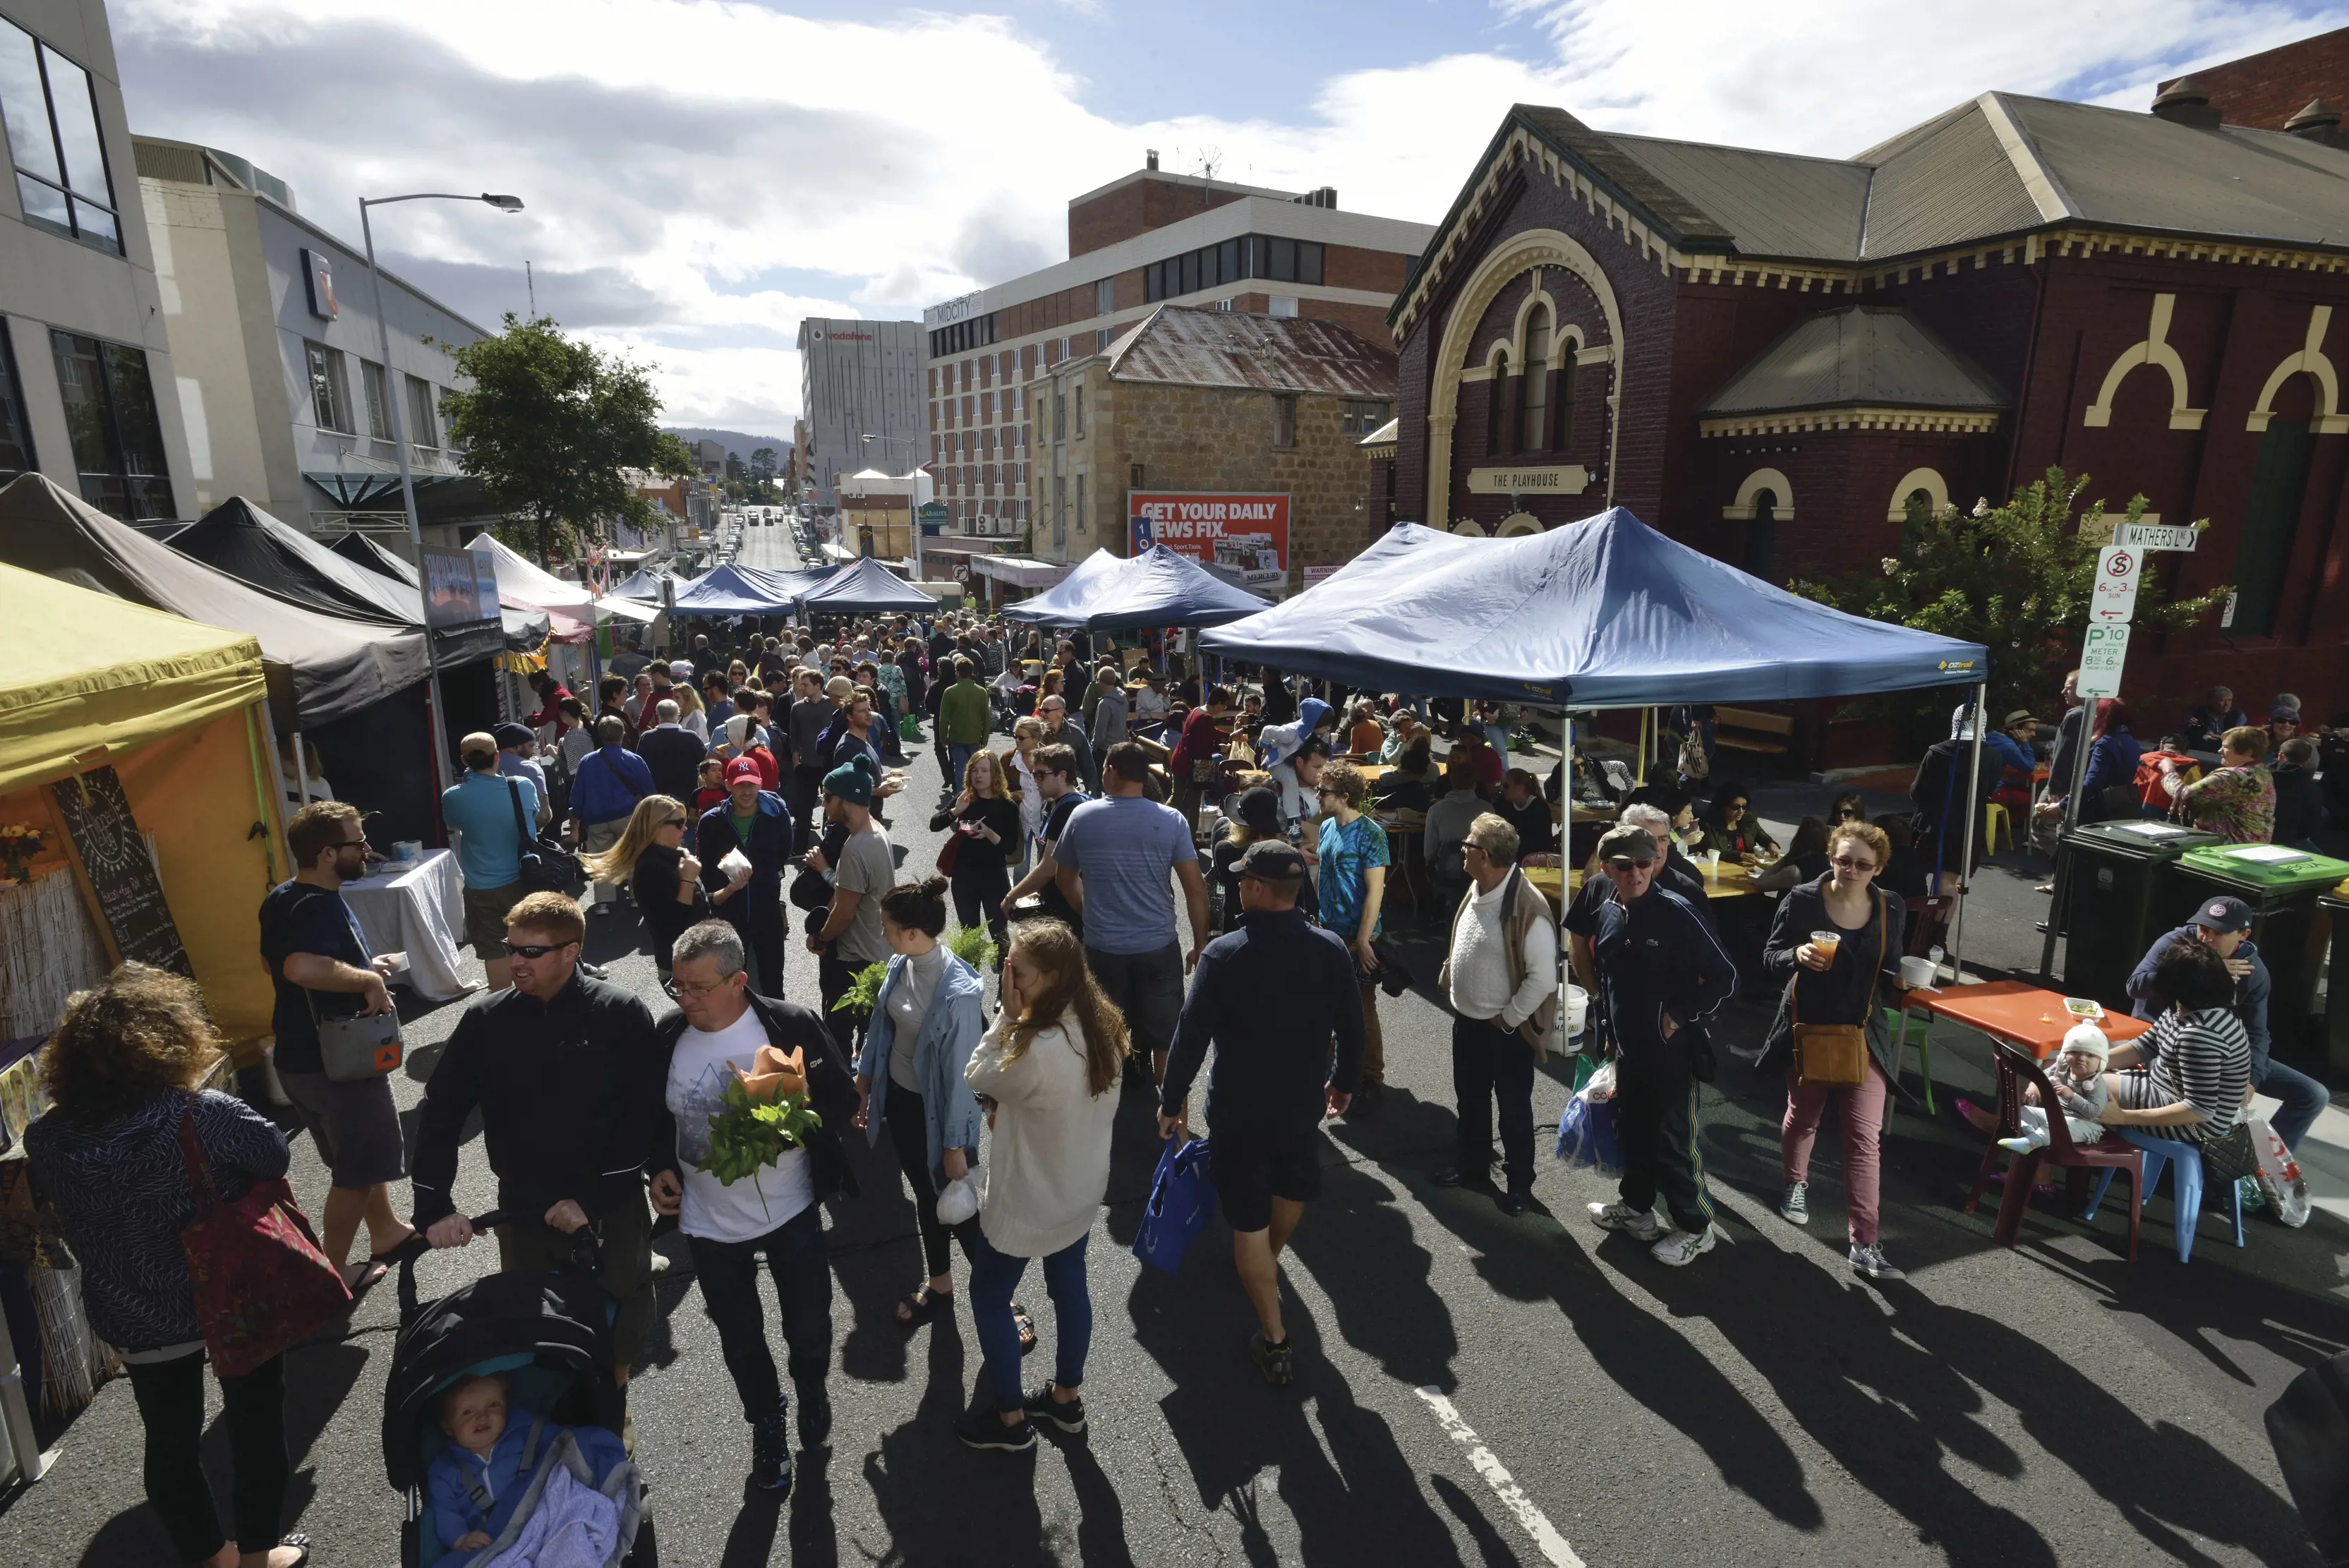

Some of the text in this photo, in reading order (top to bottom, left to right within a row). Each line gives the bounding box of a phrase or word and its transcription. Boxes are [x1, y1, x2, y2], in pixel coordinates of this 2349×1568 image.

[937, 298, 971, 325] MIDCITY
[828, 331, 873, 341] vodafone
[1494, 474, 1559, 487] THE PLAYHOUSE
[1140, 502, 1277, 520] GET YOUR DAILY
[1196, 521, 1228, 538] FIX.
[2129, 527, 2173, 547] MATHERS
[1246, 572, 1279, 581] MERCURY
[2087, 629, 2125, 646] P 10
[739, 761, 749, 771] NY
